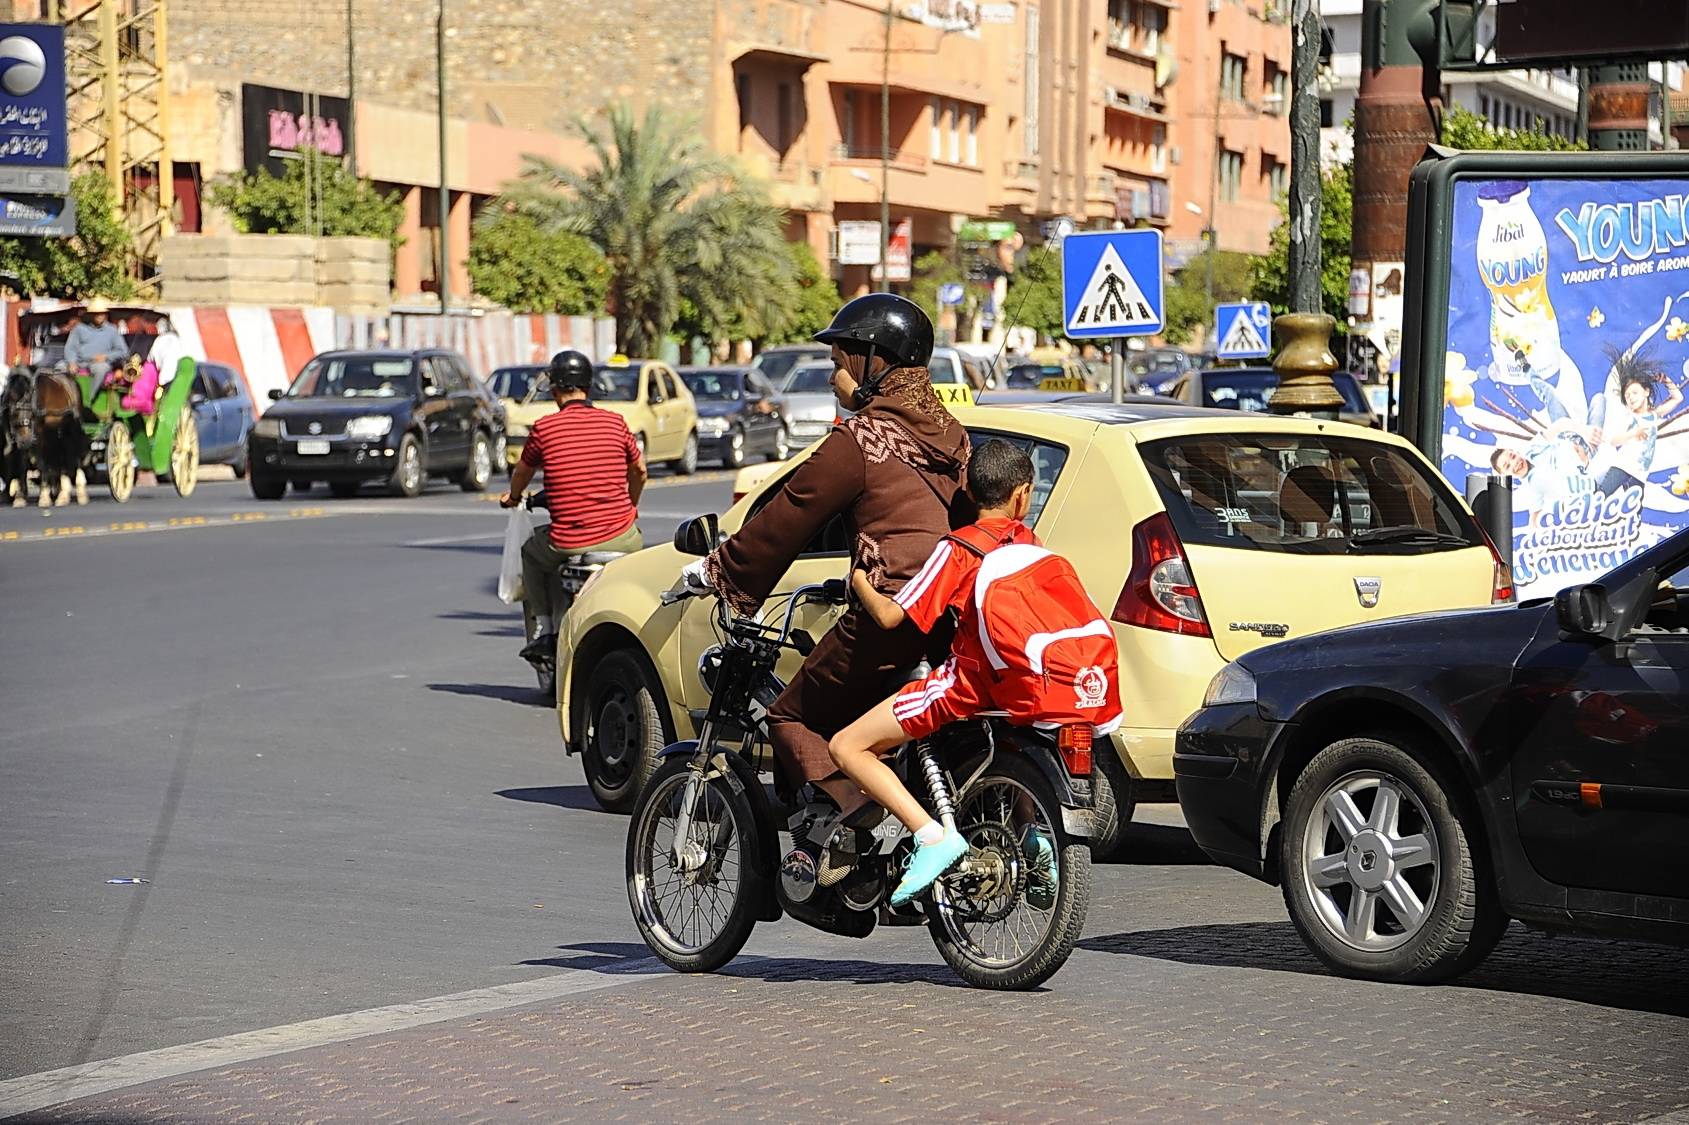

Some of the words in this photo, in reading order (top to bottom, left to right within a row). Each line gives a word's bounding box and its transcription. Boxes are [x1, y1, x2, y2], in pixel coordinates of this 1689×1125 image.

[1492, 223, 1525, 243] Jibal
[1555, 194, 1689, 263] YOUN
[1479, 246, 1545, 287] YOUNG
[1561, 269, 1606, 285] YAOURT
[1609, 262, 1618, 279] À
[1621, 260, 1654, 276] BOIRE
[935, 388, 967, 403] AXI
[1046, 380, 1072, 390] TAXI
[1540, 489, 1640, 528] délice
[1523, 515, 1636, 549] débordant
